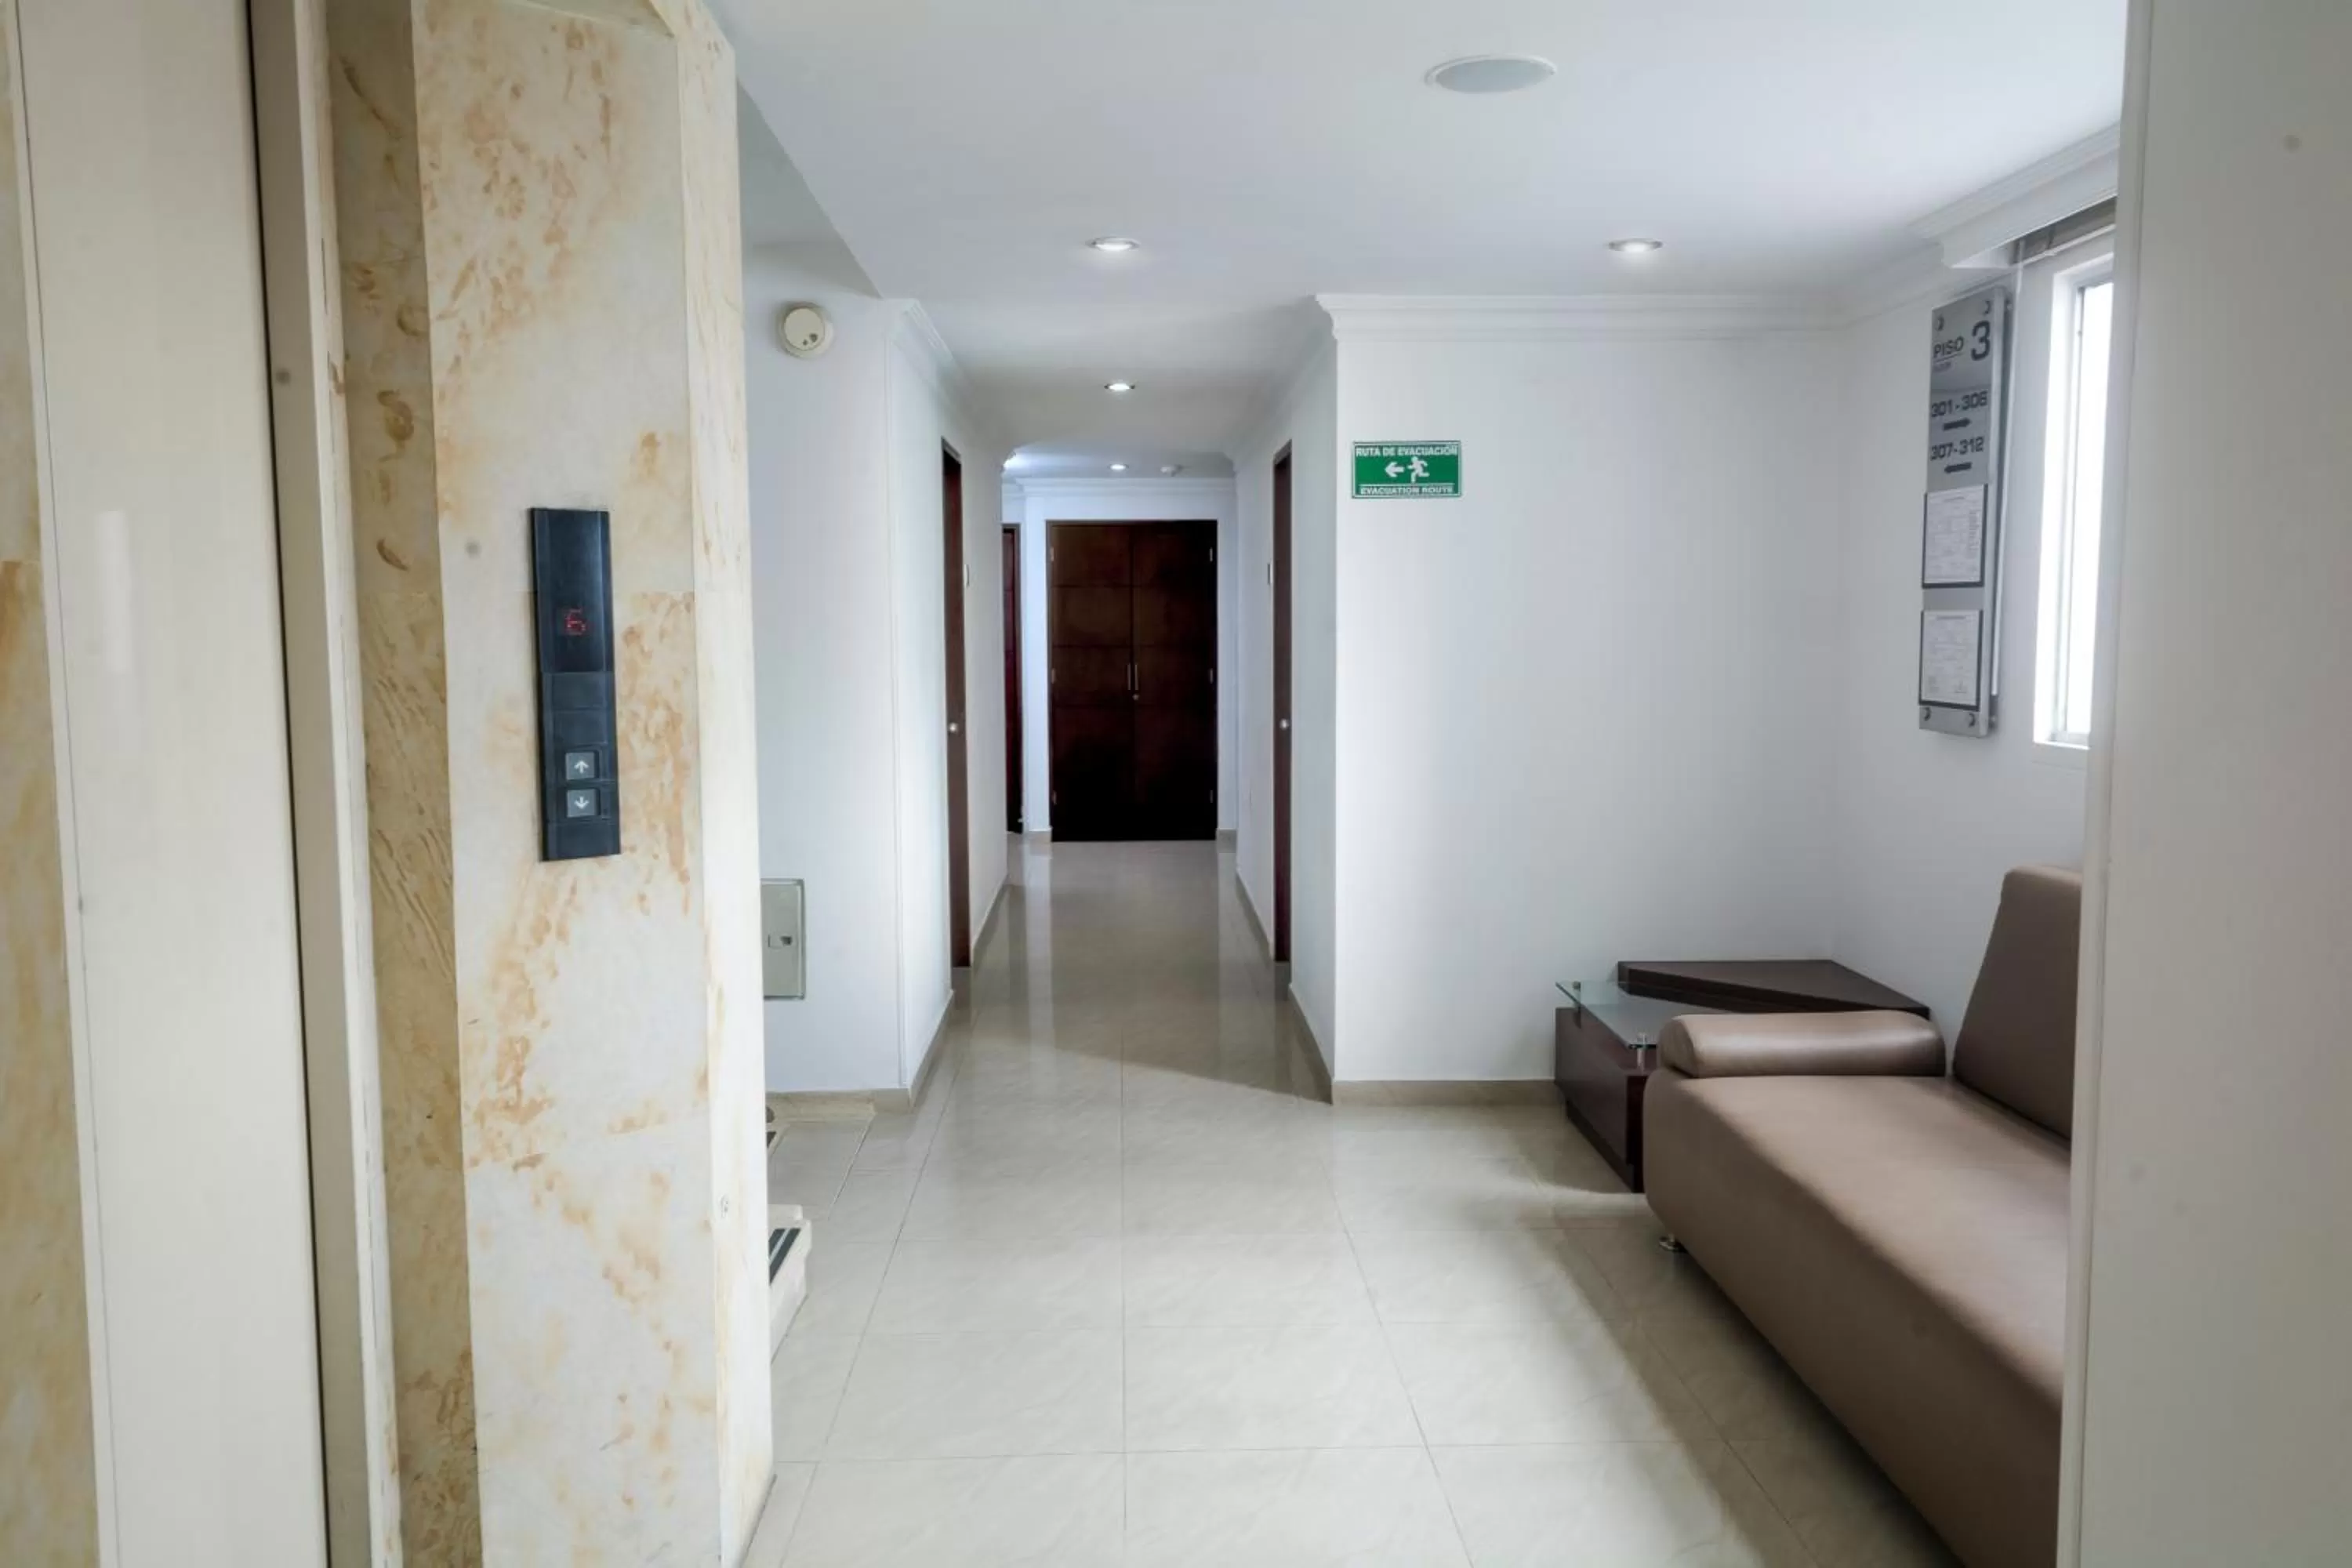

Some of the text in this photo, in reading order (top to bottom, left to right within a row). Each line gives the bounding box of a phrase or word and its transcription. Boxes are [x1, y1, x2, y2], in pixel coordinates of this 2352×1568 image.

[1933, 320, 1991, 361] PISO 3
[1356, 447, 1380, 456] RUTA
[1382, 446, 1396, 456] DE
[1360, 487, 1420, 495] EVACUATION
